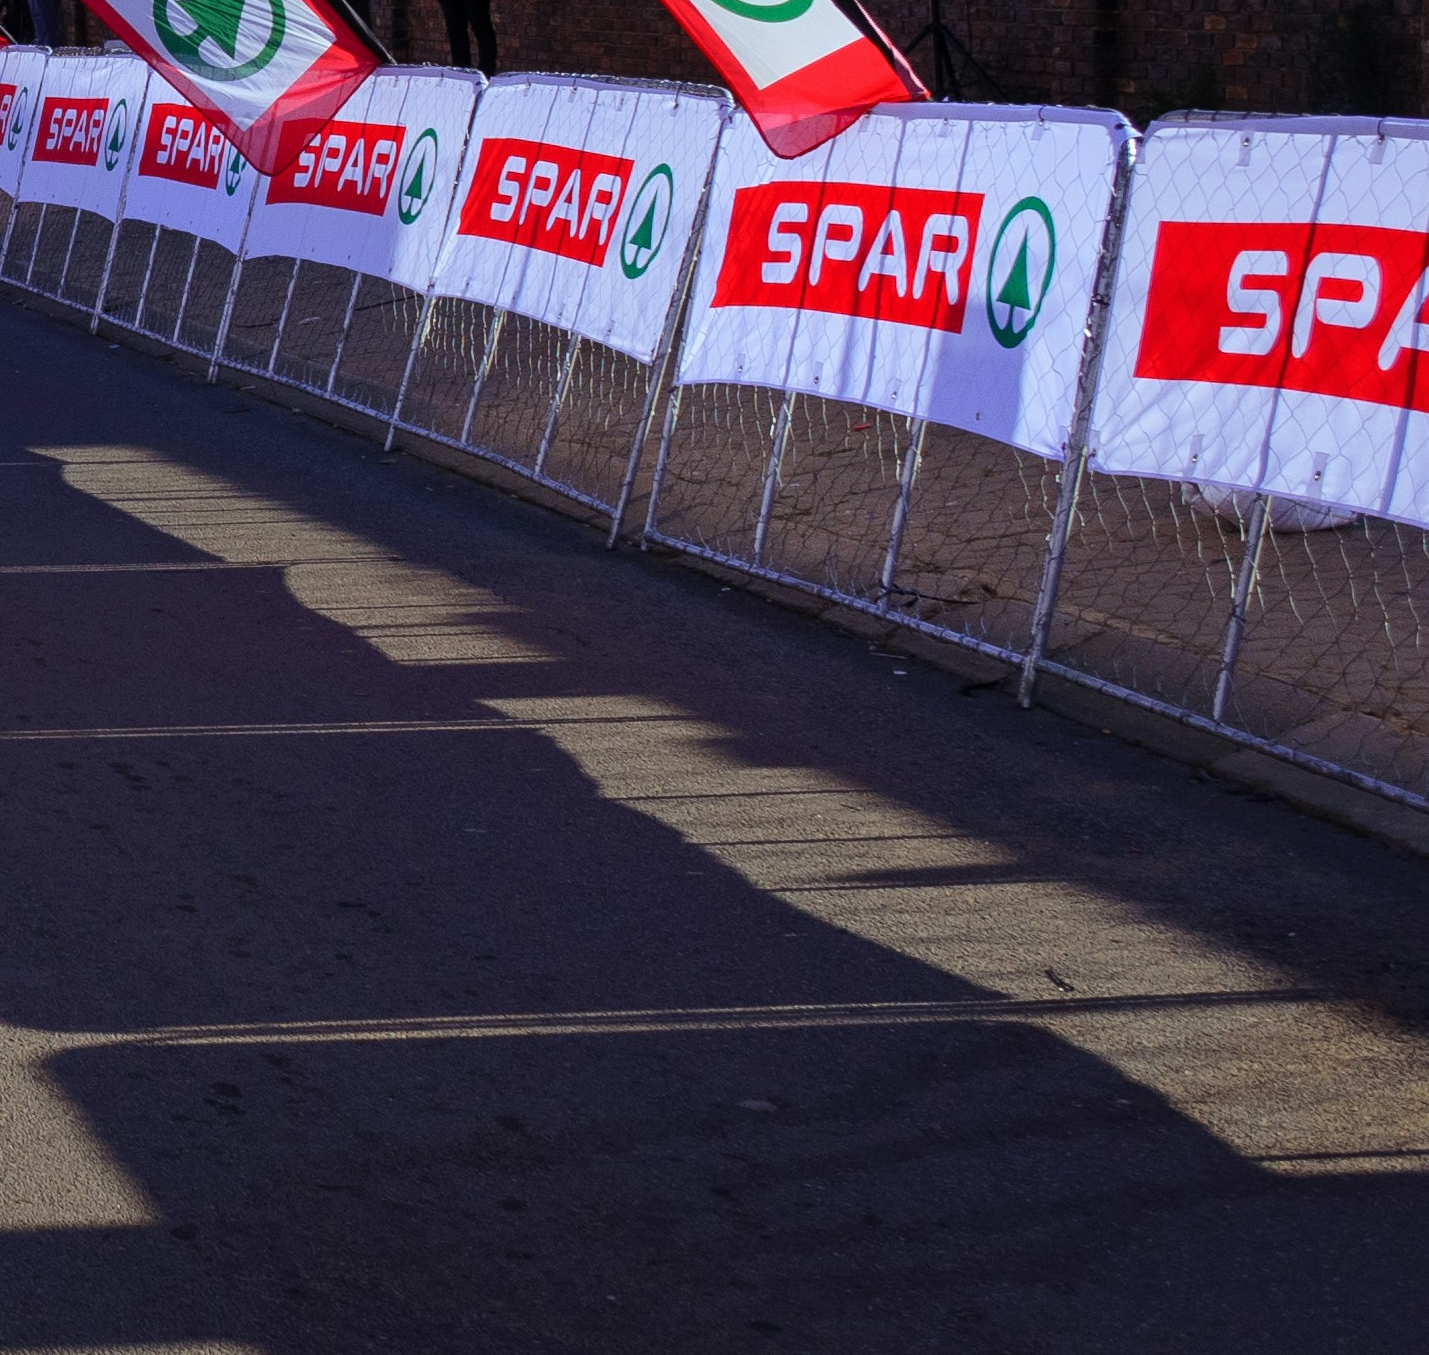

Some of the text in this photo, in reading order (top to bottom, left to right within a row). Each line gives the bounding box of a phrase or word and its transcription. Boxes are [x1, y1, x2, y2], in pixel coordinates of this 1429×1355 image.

[46, 107, 104, 154] SPAR
[160, 116, 226, 175] SPAR
[293, 133, 395, 198] SPAR
[490, 156, 622, 246] SPAR
[761, 202, 969, 306] SPAR
[1218, 250, 1429, 371] SPA
